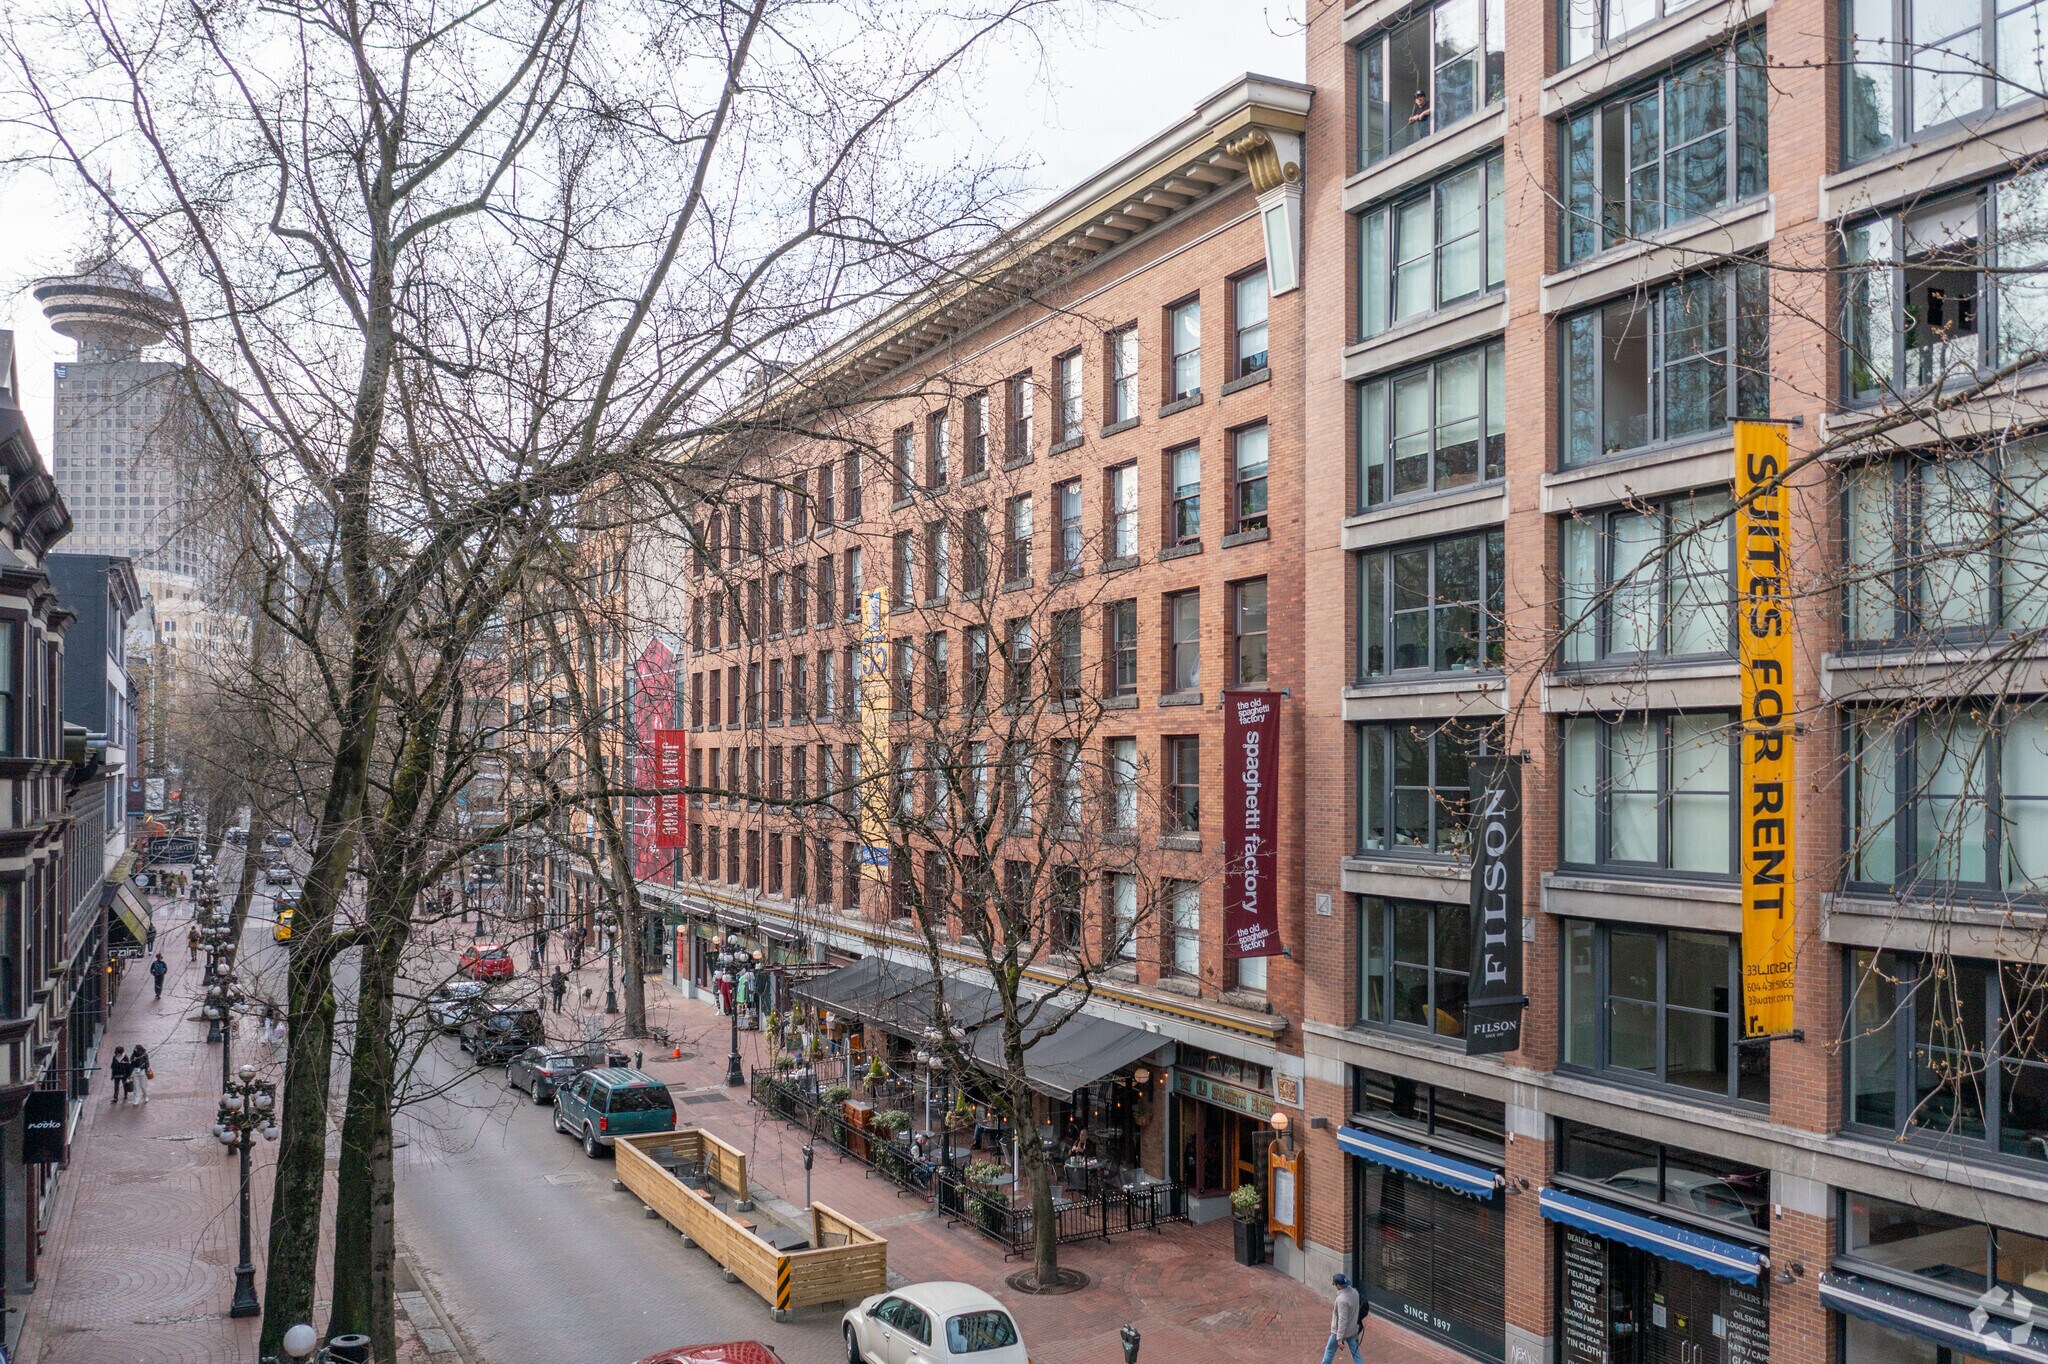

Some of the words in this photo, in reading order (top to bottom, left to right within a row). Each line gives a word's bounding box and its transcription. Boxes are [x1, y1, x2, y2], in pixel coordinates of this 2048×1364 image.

[1747, 454, 1781, 638] SUITES
[1237, 702, 1249, 710] the
[1250, 698, 1261, 708] old
[1238, 704, 1270, 718] spaghetti
[1752, 659, 1782, 763] FOR
[1239, 714, 1265, 725] factory
[1242, 731, 1261, 829] spaghetti
[662, 778, 680, 835] FUEVOG
[1753, 782, 1785, 919] RENT
[1242, 833, 1260, 914] factory
[1484, 787, 1506, 985] FILSON
[1237, 928, 1249, 937] the
[1249, 923, 1260, 934] old
[1239, 929, 1269, 945] spaghetti
[1241, 939, 1265, 952] factory
[1473, 1021, 1517, 1034] FILSON
[1211, 1083, 1248, 1110] SPAGHETTI
[1567, 1233, 1592, 1247] DEALERS
[1594, 1242, 1601, 1250] IN
[1568, 1269, 1583, 1279] FIELD
[1584, 1275, 1601, 1285] BAGS
[1572, 1280, 1595, 1293] DUFFLES
[1571, 1289, 1597, 1303] BACKPACKS
[1730, 1289, 1761, 1305] DEALERS
[1573, 1299, 1595, 1313] TOOLS
[1404, 1304, 1428, 1322] SINCE
[1433, 1317, 1451, 1332] 1897
[1564, 1307, 1583, 1319] BOOKS
[1587, 1316, 1604, 1328] MAPS
[1733, 1311, 1766, 1328] OILSKINS
[1726, 1320, 1751, 1334] LOGGER
[1752, 1329, 1769, 1341] COAT
[1567, 1337, 1578, 1348] TIN
[1579, 1343, 1602, 1358] CLOTH
[1586, 1336, 1601, 1346] GEAR
[1727, 1341, 1746, 1355] HATS
